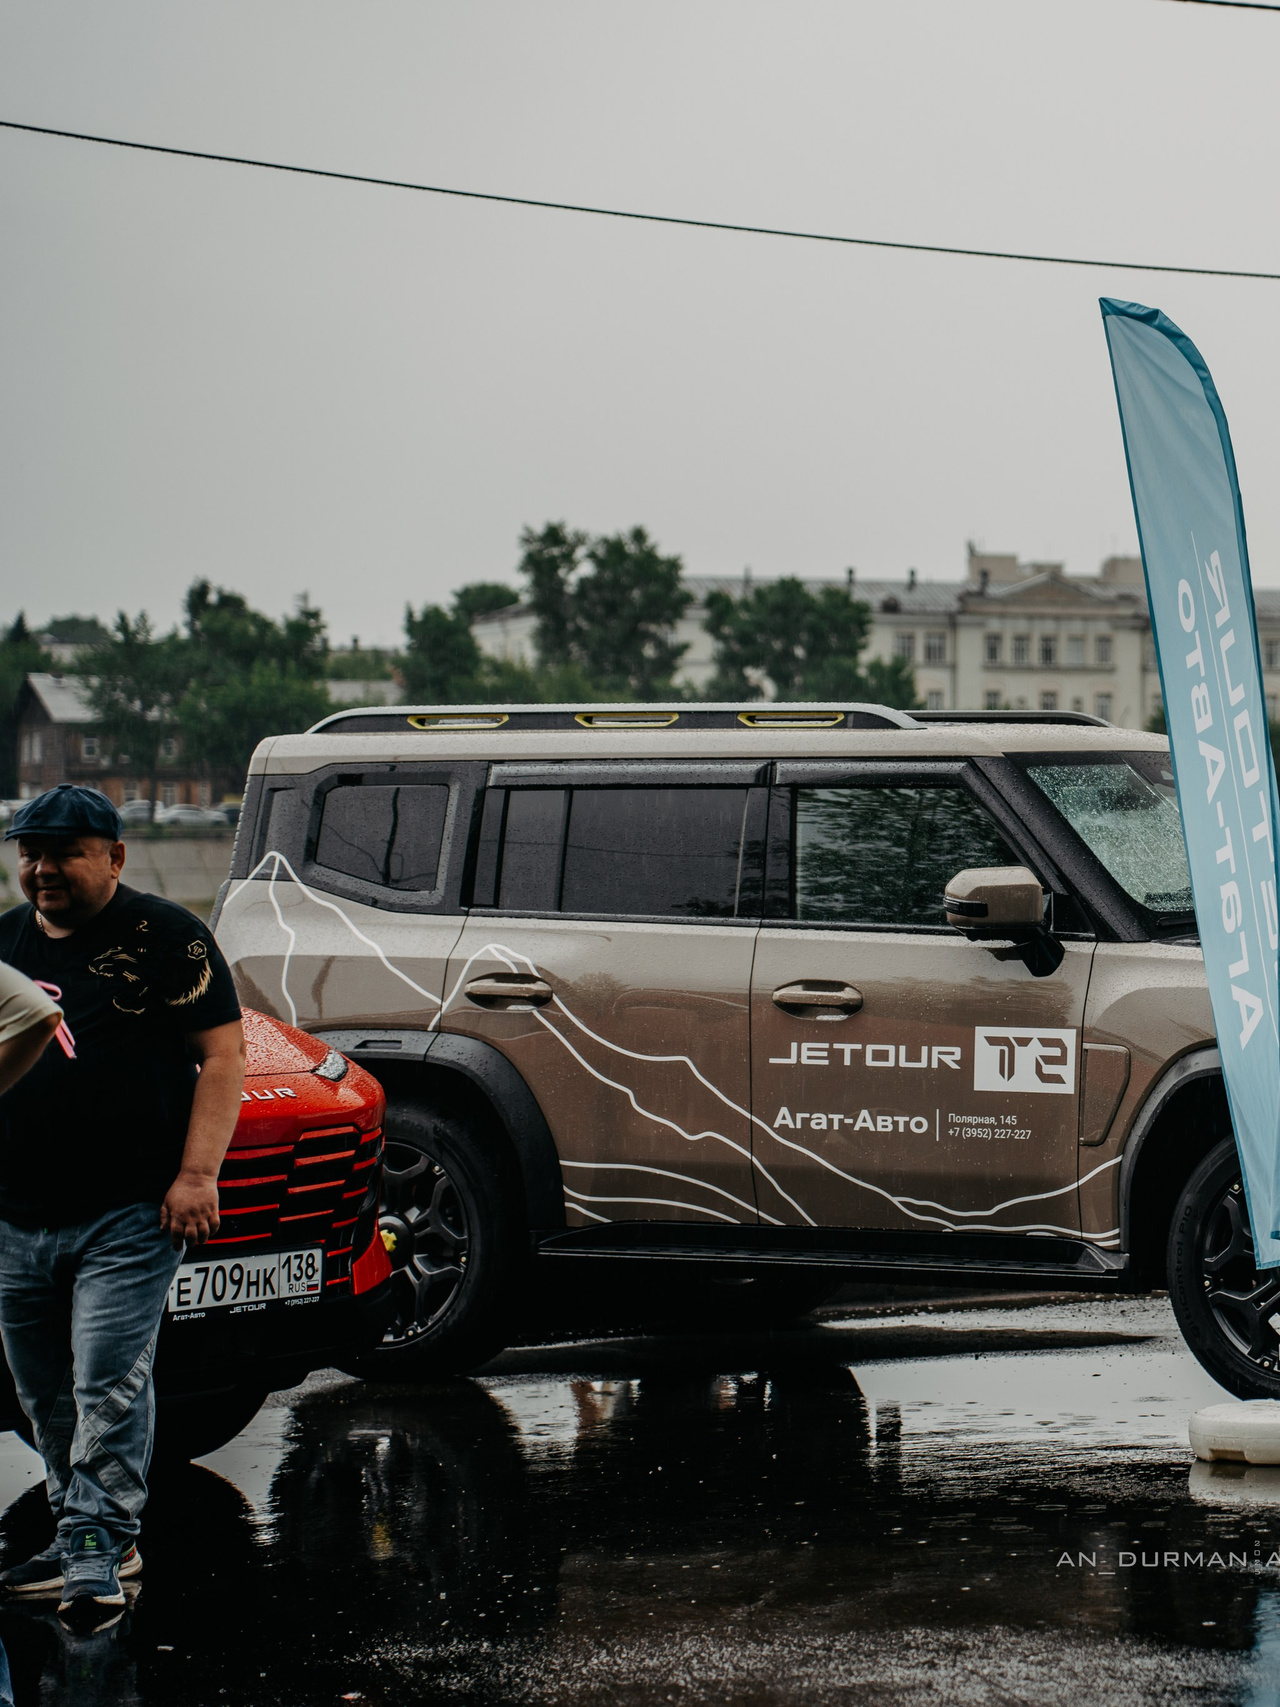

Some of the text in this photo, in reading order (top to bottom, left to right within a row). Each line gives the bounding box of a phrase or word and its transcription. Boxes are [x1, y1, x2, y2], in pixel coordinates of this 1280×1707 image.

[768, 1035, 1068, 1085] JETOUR T2
[773, 1106, 929, 1134] Агат-Авто
[948, 1113, 1018, 1126] Полярная, 145
[948, 1127, 1032, 1140] +7 (3952) 227-227
[281, 1252, 316, 1284] 138
[288, 1281, 306, 1294] RUS
[229, 1302, 267, 1314] JETOUR
[172, 1311, 206, 1322] Агат-Авто
